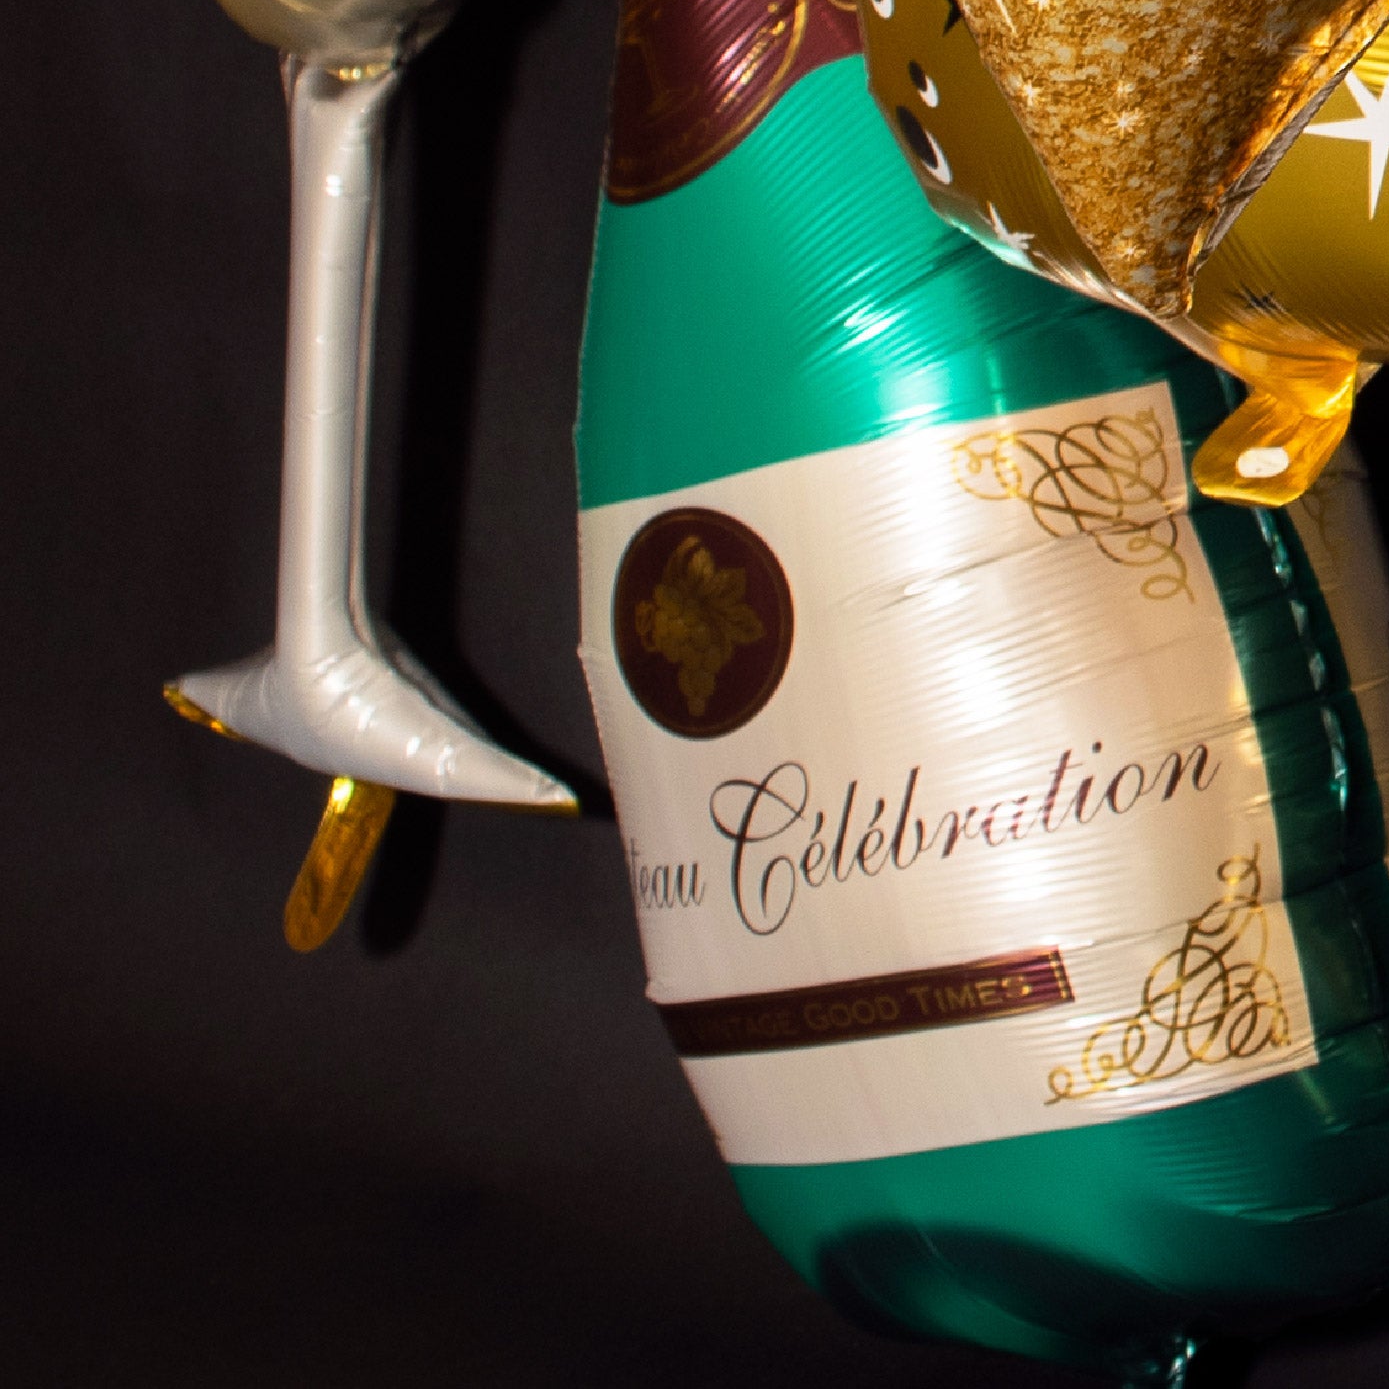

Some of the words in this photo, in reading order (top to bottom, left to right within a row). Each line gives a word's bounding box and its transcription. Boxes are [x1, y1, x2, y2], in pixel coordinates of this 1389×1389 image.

[708, 741, 1225, 937] Célébration
[802, 994, 901, 1033] GOOD
[907, 974, 1033, 1018] TIMES
